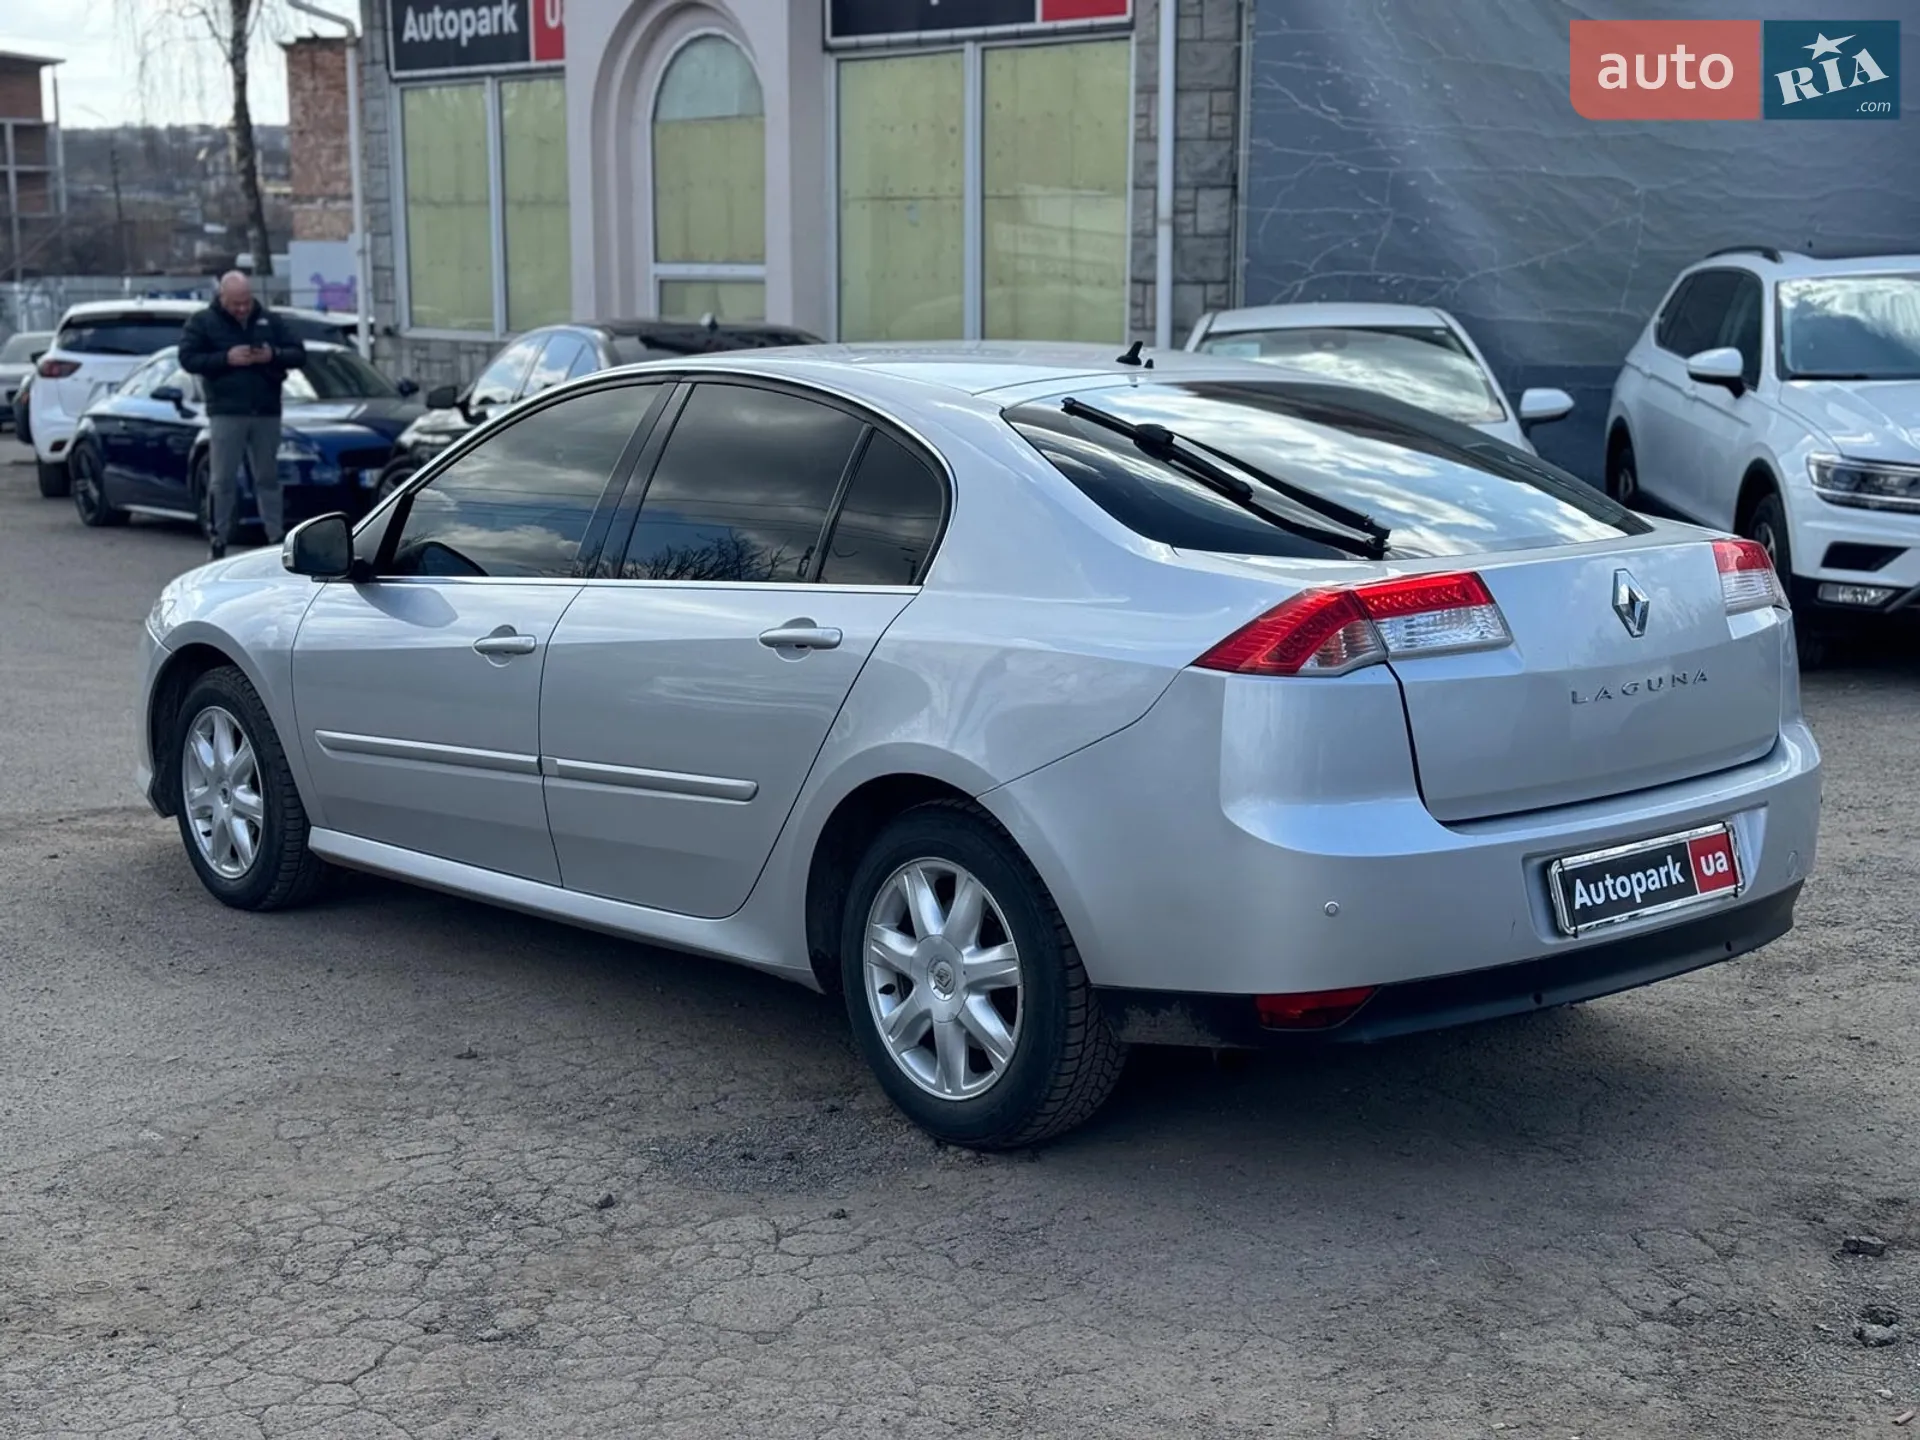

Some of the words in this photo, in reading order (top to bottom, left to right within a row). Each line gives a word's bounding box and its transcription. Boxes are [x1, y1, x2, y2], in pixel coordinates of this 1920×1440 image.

[402, 0, 519, 47] Autopark
[1570, 668, 1708, 705] LAGUNA
[1574, 855, 1685, 910] Autopark
[1700, 850, 1729, 877] ua
